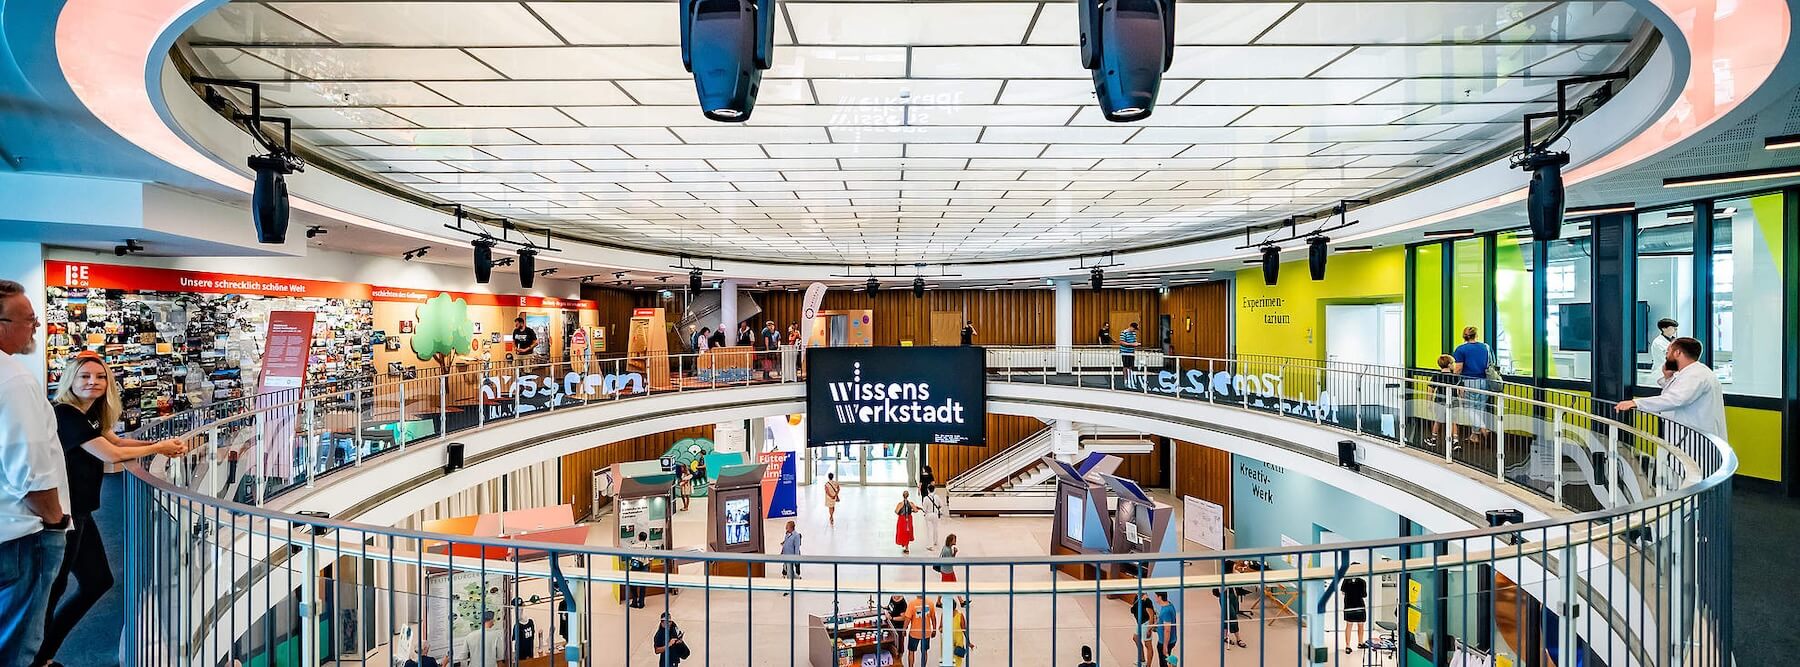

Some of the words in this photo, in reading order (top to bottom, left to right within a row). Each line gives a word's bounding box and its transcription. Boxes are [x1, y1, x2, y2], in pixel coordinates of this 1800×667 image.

[180, 277, 213, 288] Unsere
[214, 278, 261, 291] schrecklich
[261, 281, 289, 292] schöne
[290, 283, 306, 293] Welt
[1243, 295, 1285, 312] Experimen-
[1264, 311, 1290, 324] tarium
[829, 365, 930, 402] Wissens
[835, 397, 965, 424] Werkstadt
[763, 469, 782, 479] irn!
[766, 462, 780, 471] ein
[1240, 463, 1271, 485] Kreativ-
[1252, 483, 1274, 504] Werk
